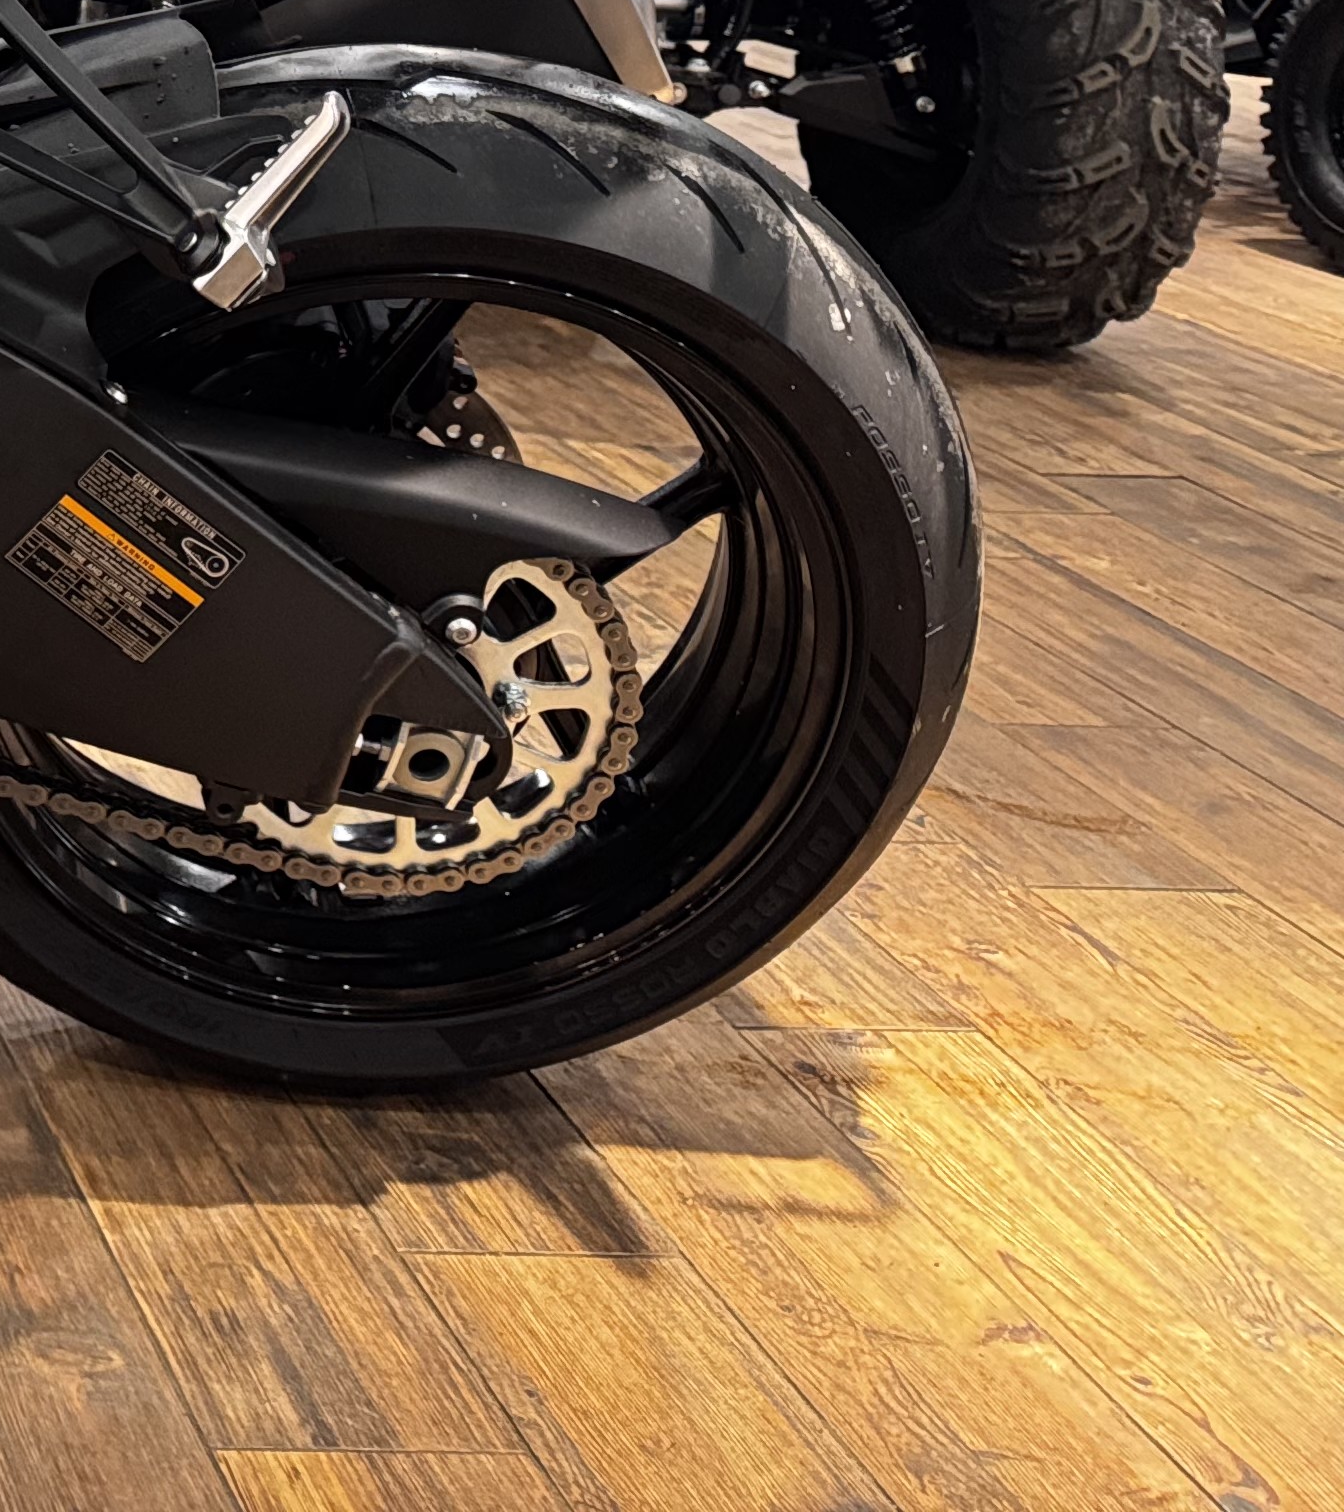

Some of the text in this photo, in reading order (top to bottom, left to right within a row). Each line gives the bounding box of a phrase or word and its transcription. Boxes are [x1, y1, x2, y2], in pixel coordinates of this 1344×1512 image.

[132, 473, 217, 541] CHAIN INFORMATION
[116, 538, 156, 571] WARNING
